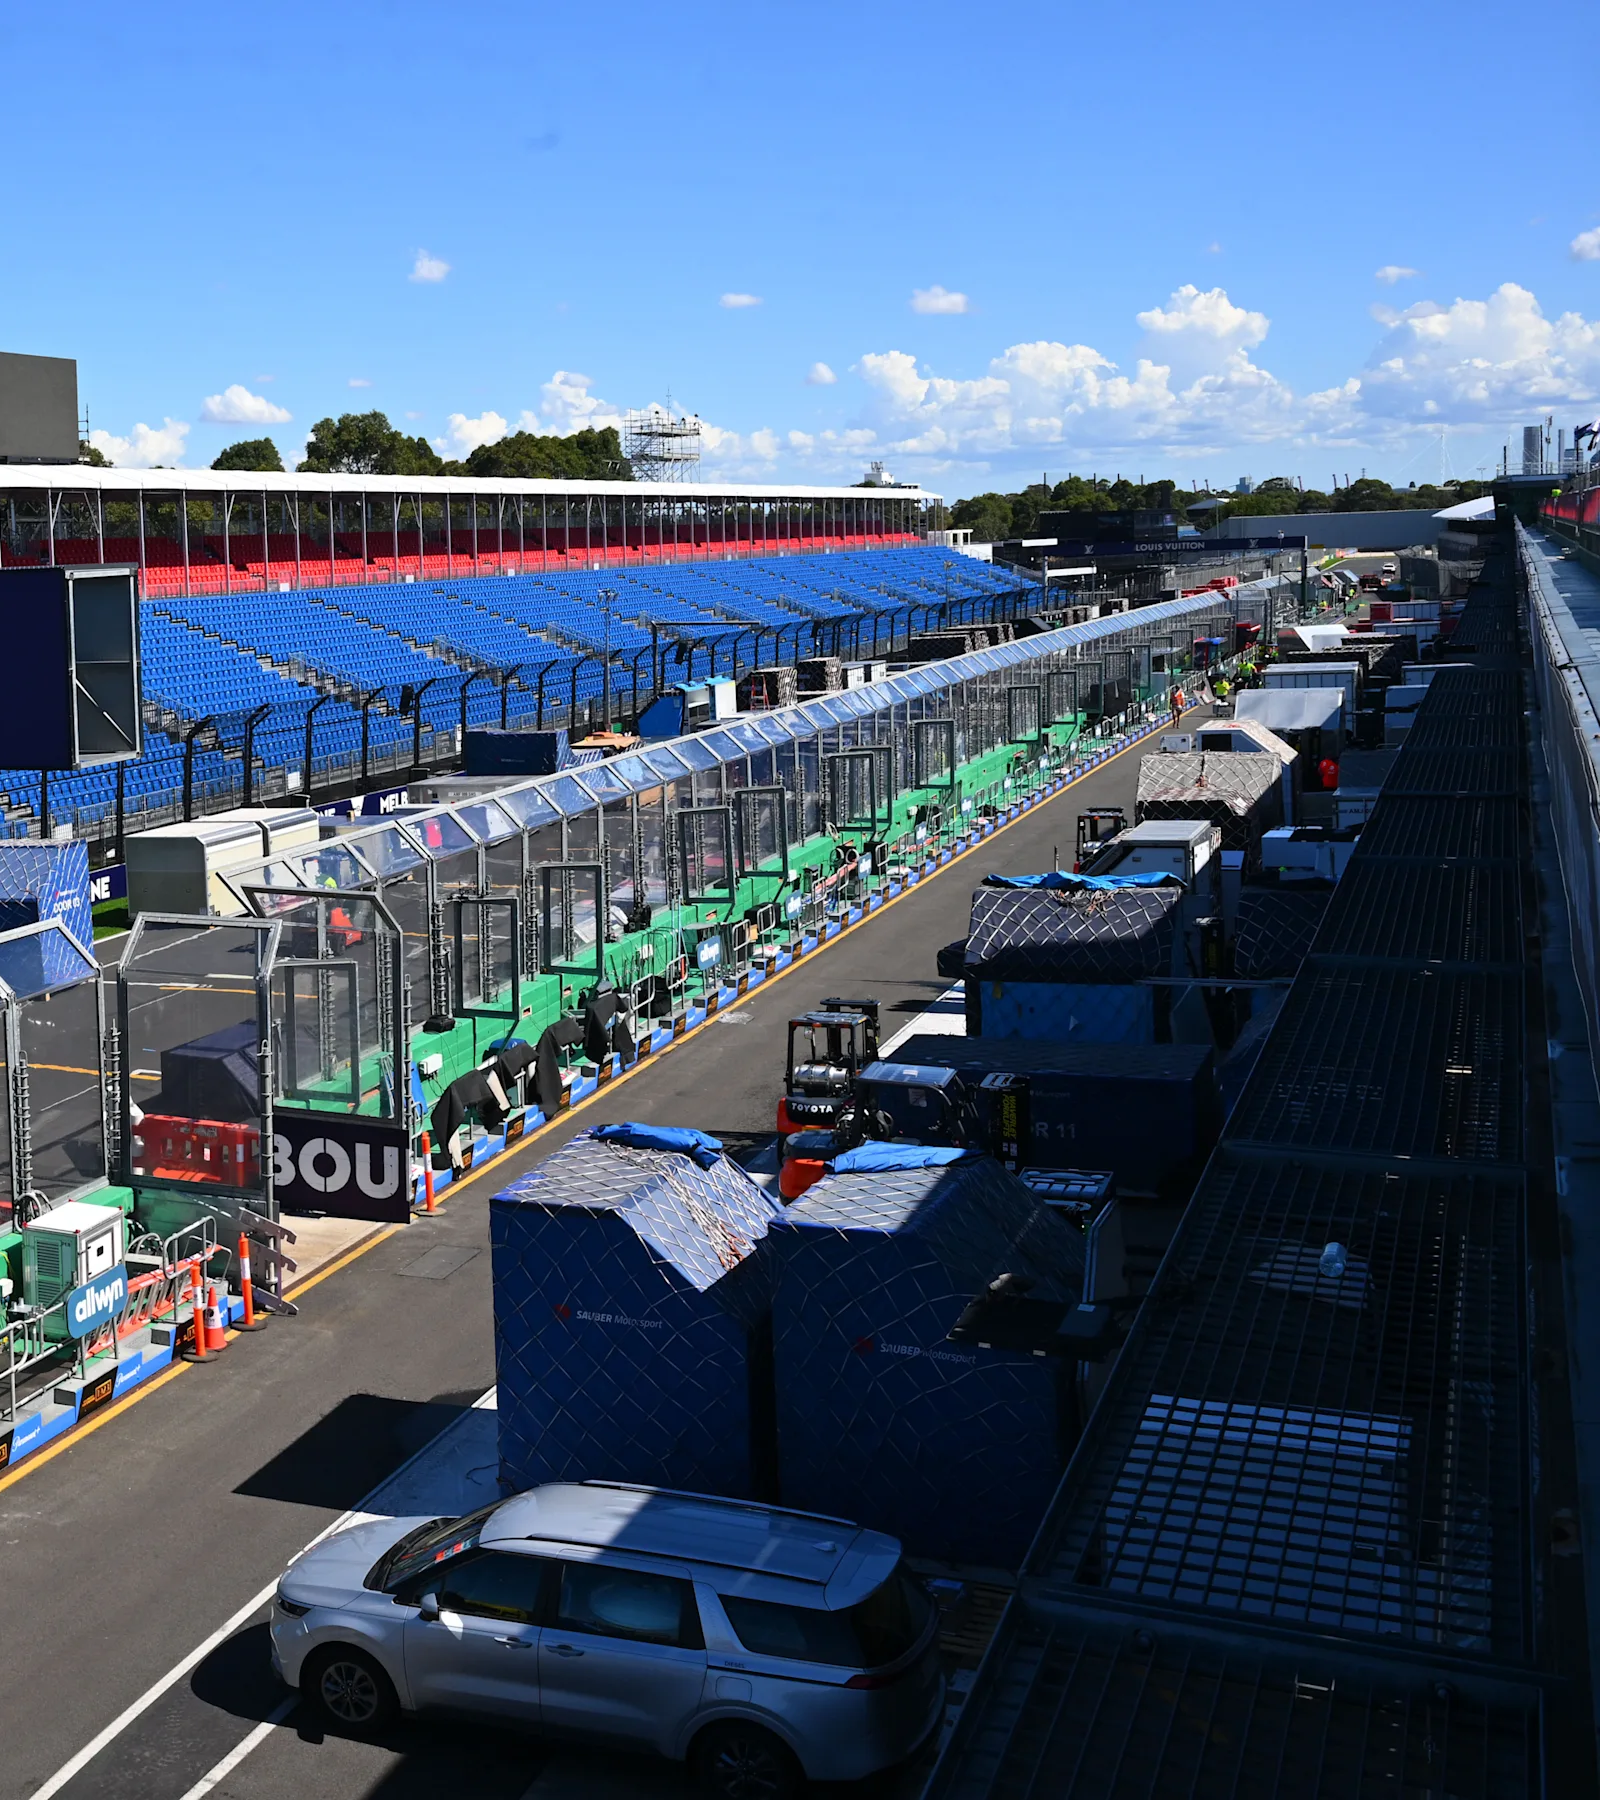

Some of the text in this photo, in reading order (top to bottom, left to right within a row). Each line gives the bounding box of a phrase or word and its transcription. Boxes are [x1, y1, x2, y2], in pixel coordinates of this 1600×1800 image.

[1135, 541, 1205, 552] LOUIS VUITTON
[792, 1102, 833, 1114] TOYOTA
[75, 1278, 123, 1323] allwyn
[576, 1310, 662, 1330] SAUBER Motorsport
[922, 1349, 977, 1365] Motorsport
